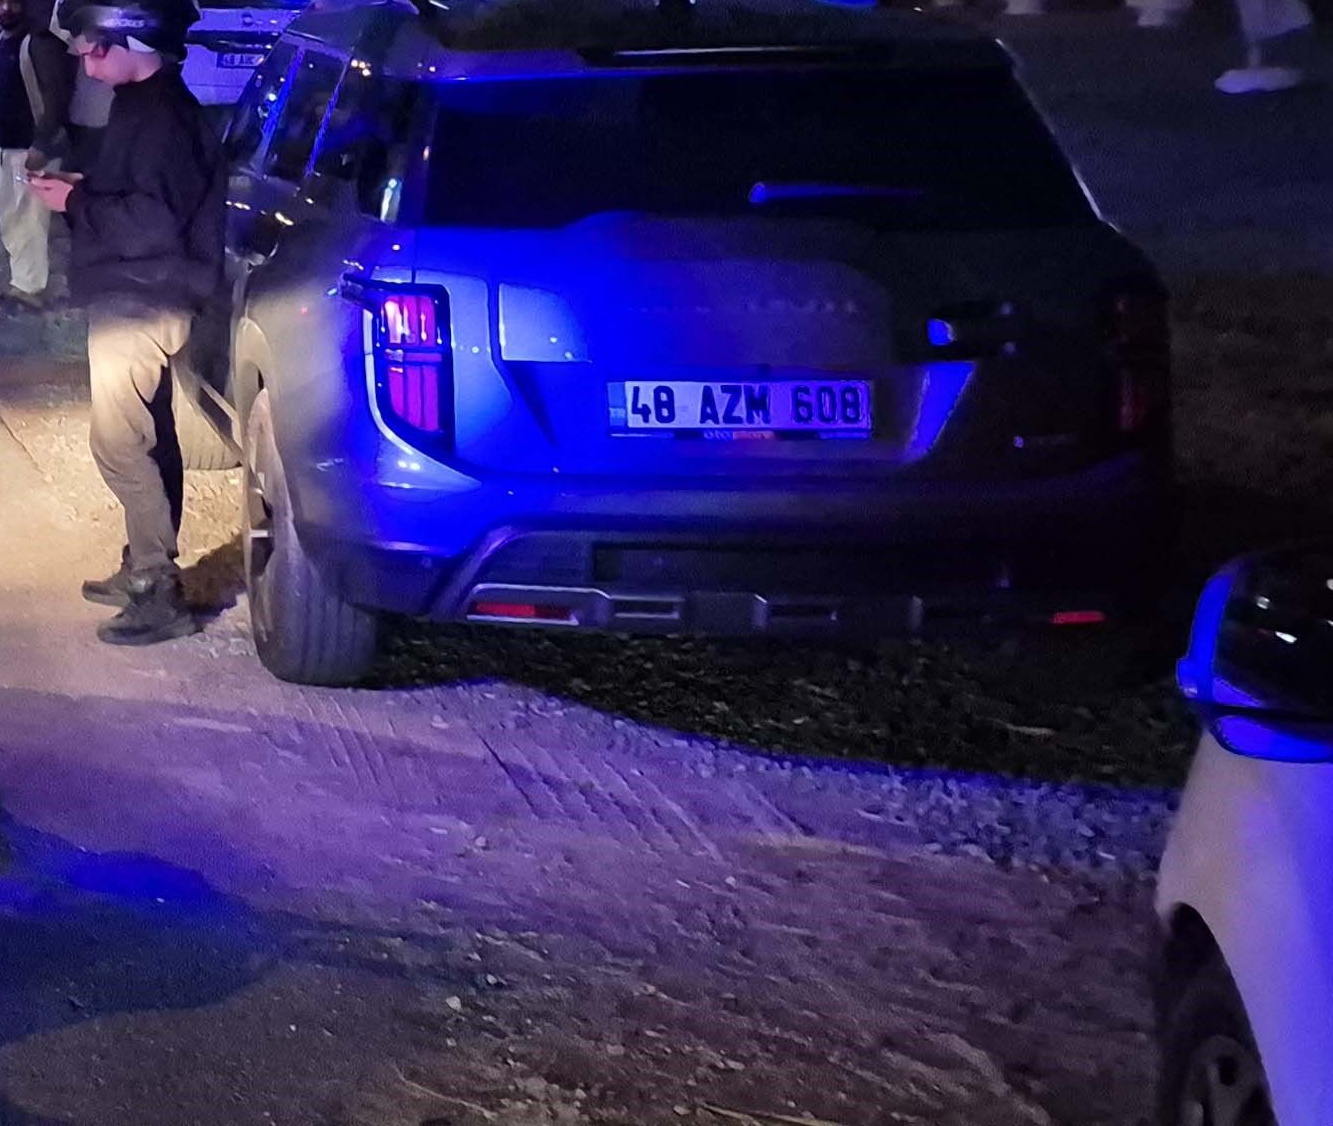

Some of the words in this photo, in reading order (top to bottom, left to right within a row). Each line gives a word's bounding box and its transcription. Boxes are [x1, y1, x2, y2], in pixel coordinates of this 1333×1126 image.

[630, 384, 676, 424] 48
[699, 385, 772, 424] AZM
[792, 385, 863, 424] 608
